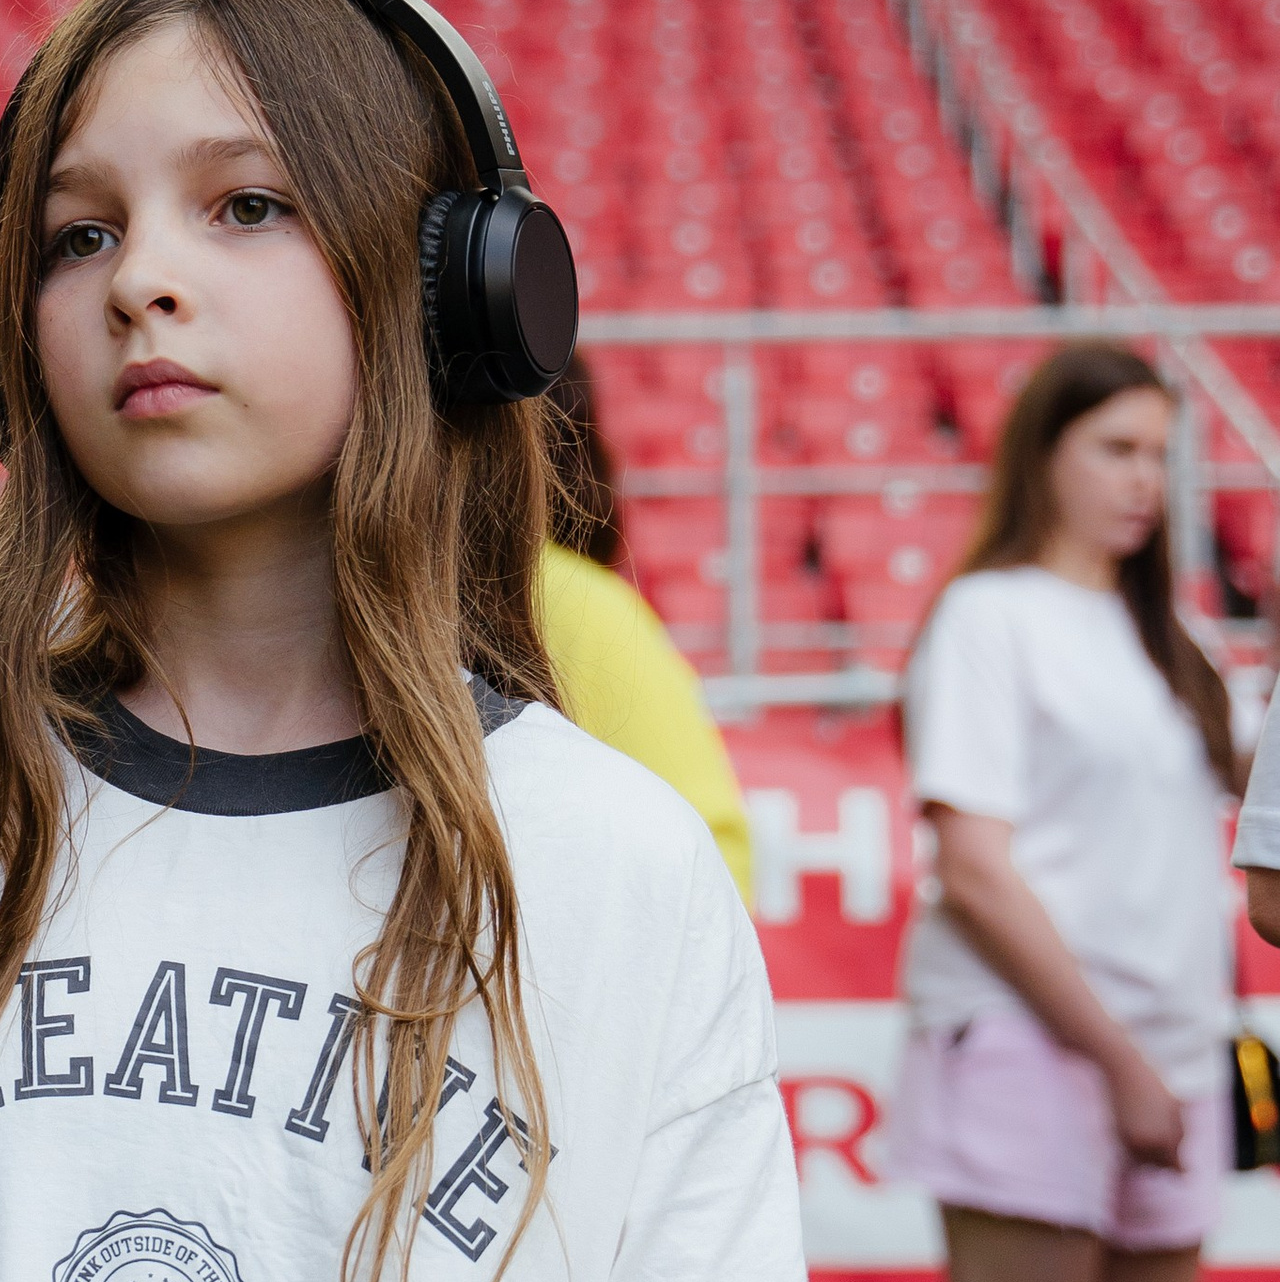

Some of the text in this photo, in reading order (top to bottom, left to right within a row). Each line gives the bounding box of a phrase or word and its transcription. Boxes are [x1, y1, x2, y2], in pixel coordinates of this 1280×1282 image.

[482, 81, 515, 155] PHILIPS
[100, 1236, 174, 1264] OUTSIDE
[175, 1245, 199, 1265] OF
